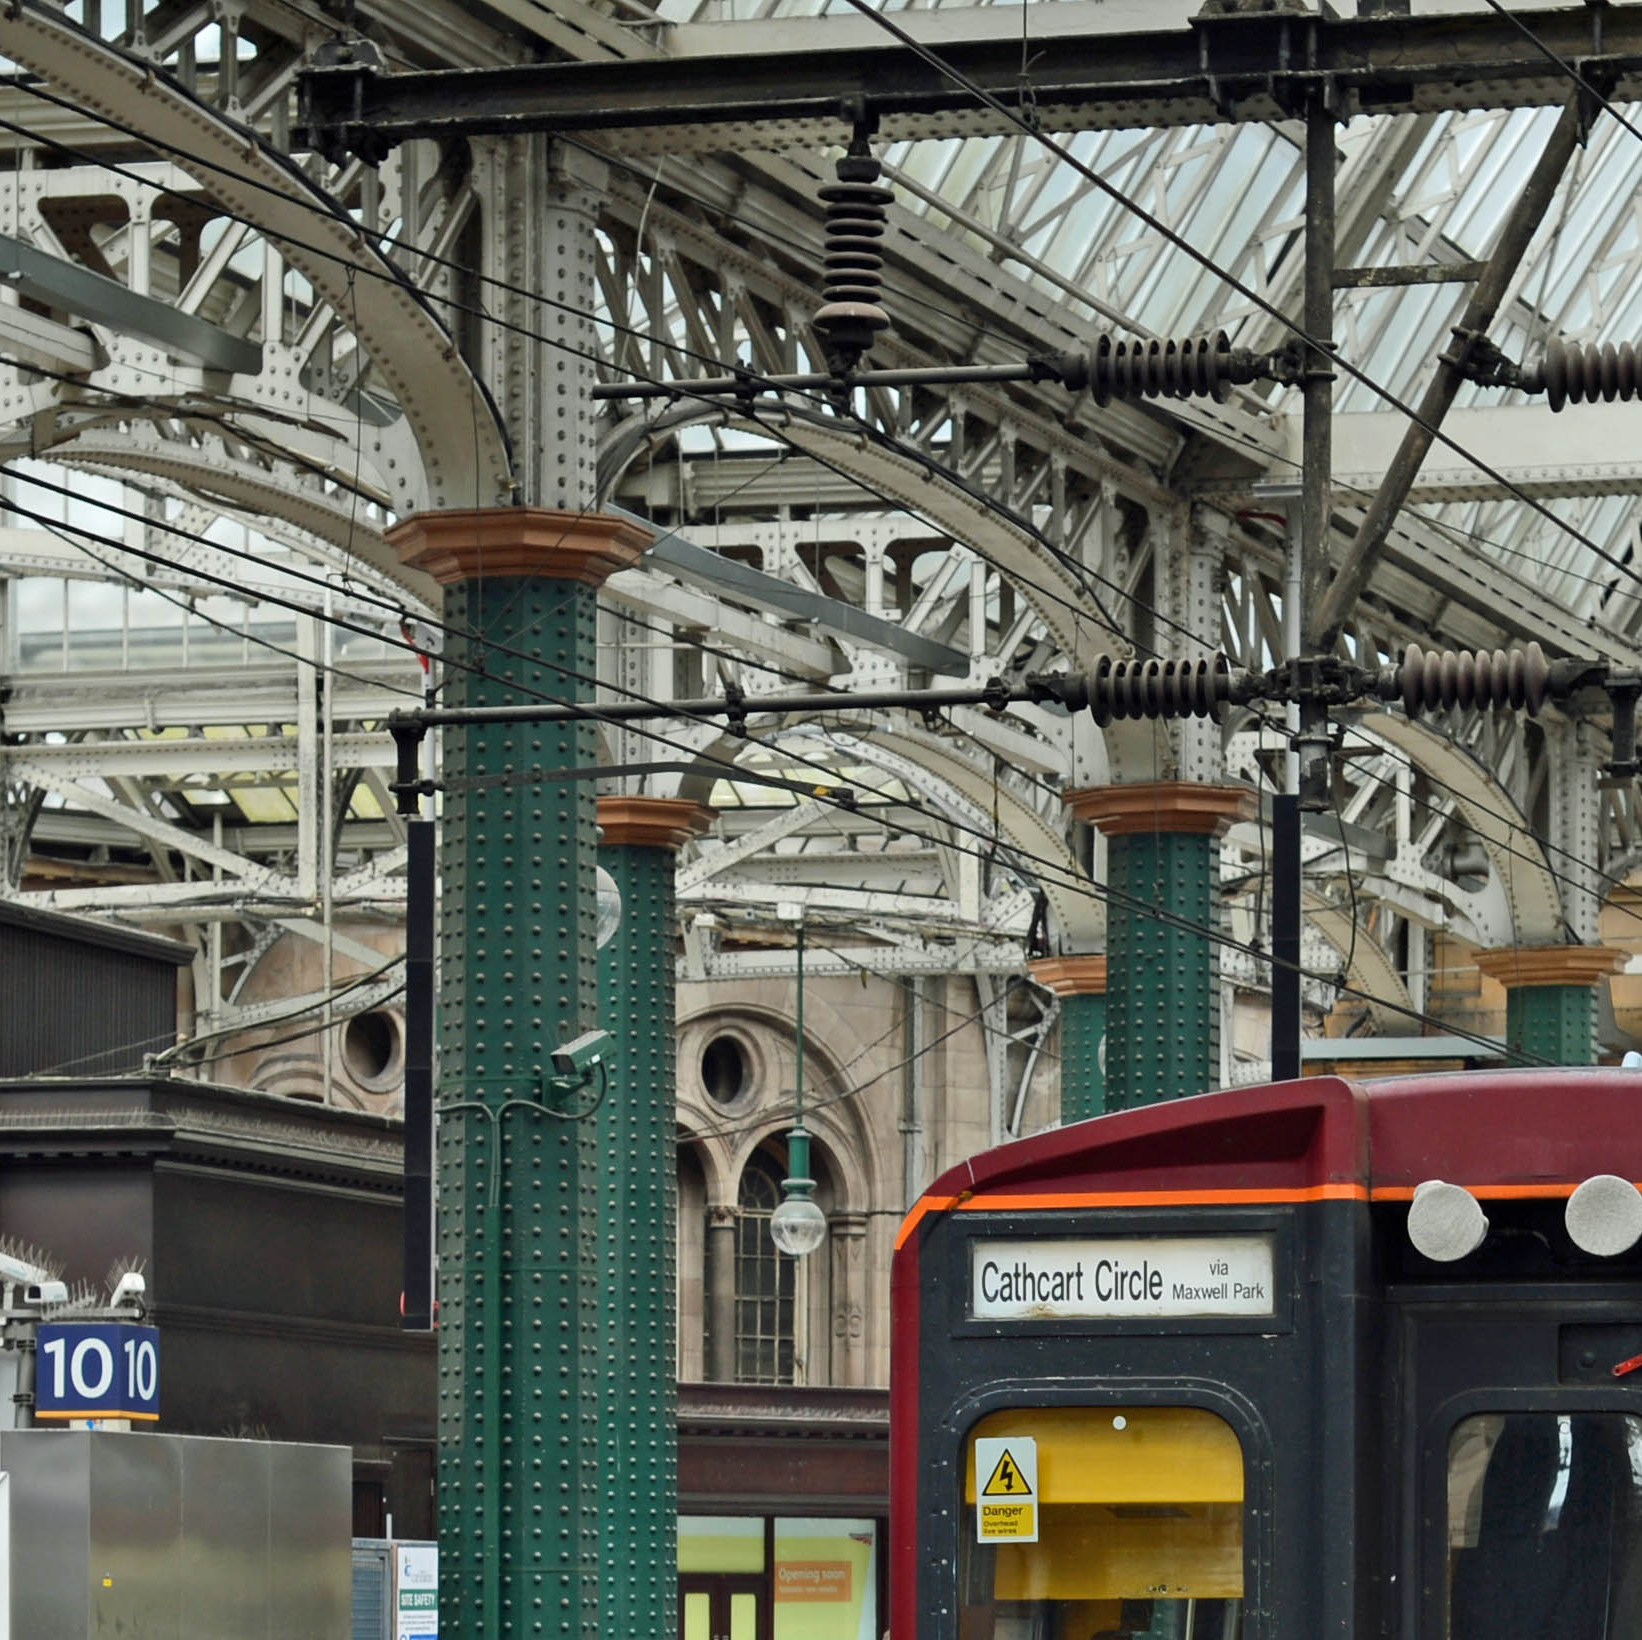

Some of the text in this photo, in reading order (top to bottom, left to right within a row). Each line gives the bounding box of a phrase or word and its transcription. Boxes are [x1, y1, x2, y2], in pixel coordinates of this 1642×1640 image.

[1209, 1259, 1229, 1276] via
[981, 1259, 1163, 1303] Cathcart Circle
[1172, 1282, 1265, 1301] Maxwell Park
[43, 1337, 157, 1401] 10 10
[982, 1506, 1023, 1518] Danger
[414, 1593, 436, 1607] SAFETY
